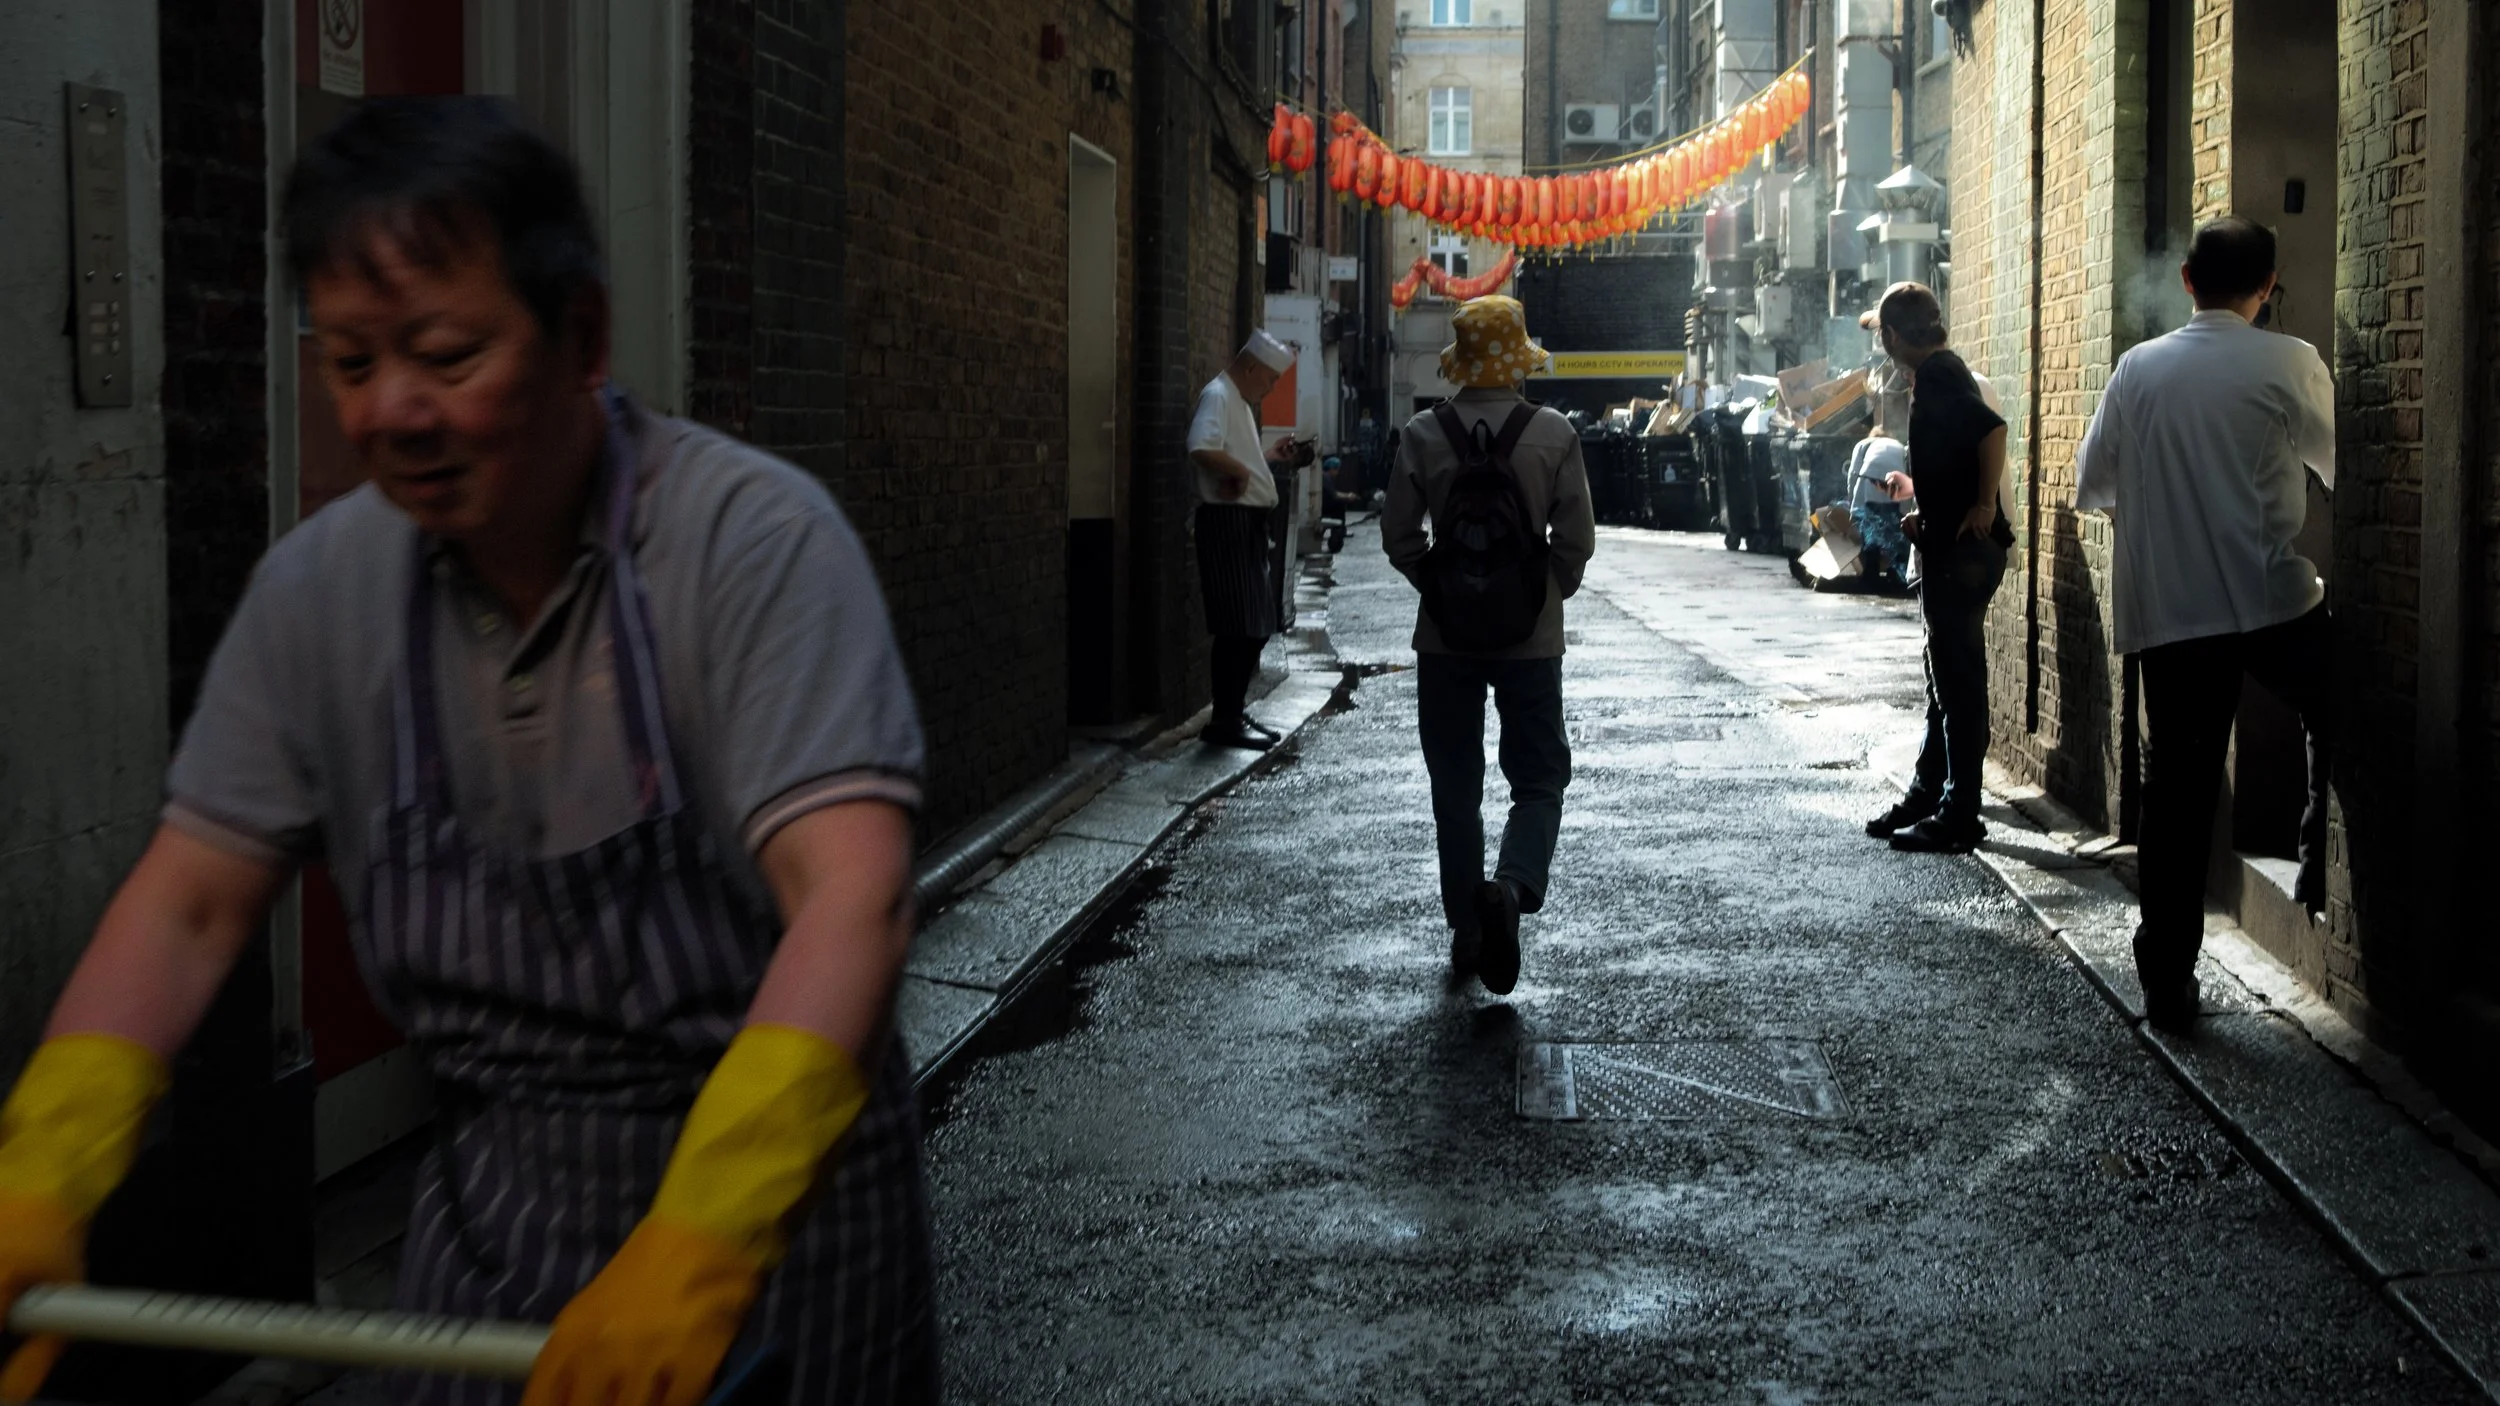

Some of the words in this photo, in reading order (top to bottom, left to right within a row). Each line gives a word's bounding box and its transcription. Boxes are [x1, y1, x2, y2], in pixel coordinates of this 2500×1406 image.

[1568, 360, 1597, 368] HOURS
[1600, 360, 1622, 368] CCTV
[1624, 359, 1632, 367] IN
[1634, 359, 1683, 367] OPERATION
